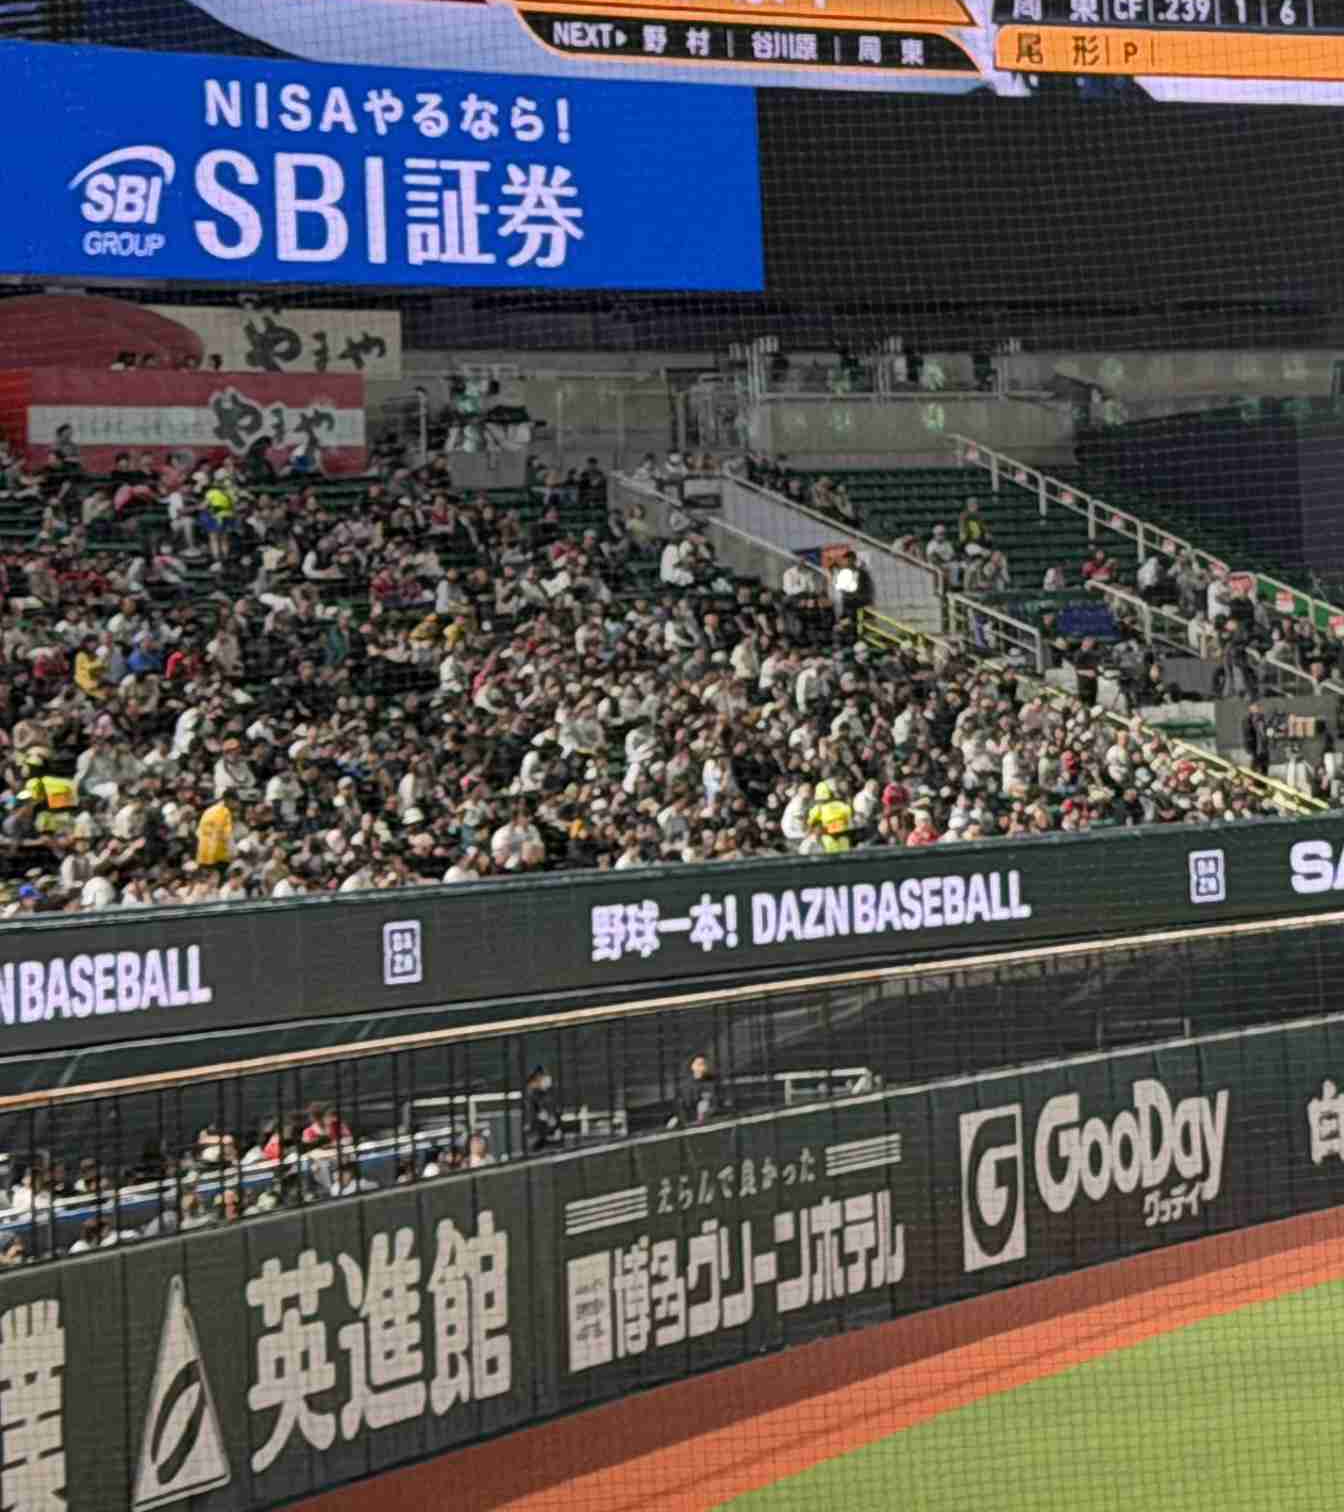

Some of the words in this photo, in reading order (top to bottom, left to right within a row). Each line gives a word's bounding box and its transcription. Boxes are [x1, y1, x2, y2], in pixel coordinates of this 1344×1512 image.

[553, 21, 614, 47] NEXT
[205, 80, 572, 145] NISAやるなら!
[80, 173, 162, 224] SBI
[193, 148, 584, 269] SBI証券
[82, 230, 167, 256] GROUP
[591, 891, 738, 961] 野球一本!
[1034, 1079, 1229, 1213] GooDay
[656, 1149, 817, 1215] えらんで良かった
[1143, 1184, 1200, 1228] グッデイ
[613, 1189, 905, 1355] 博多グリーンホテル
[246, 1209, 512, 1475] 英進館
